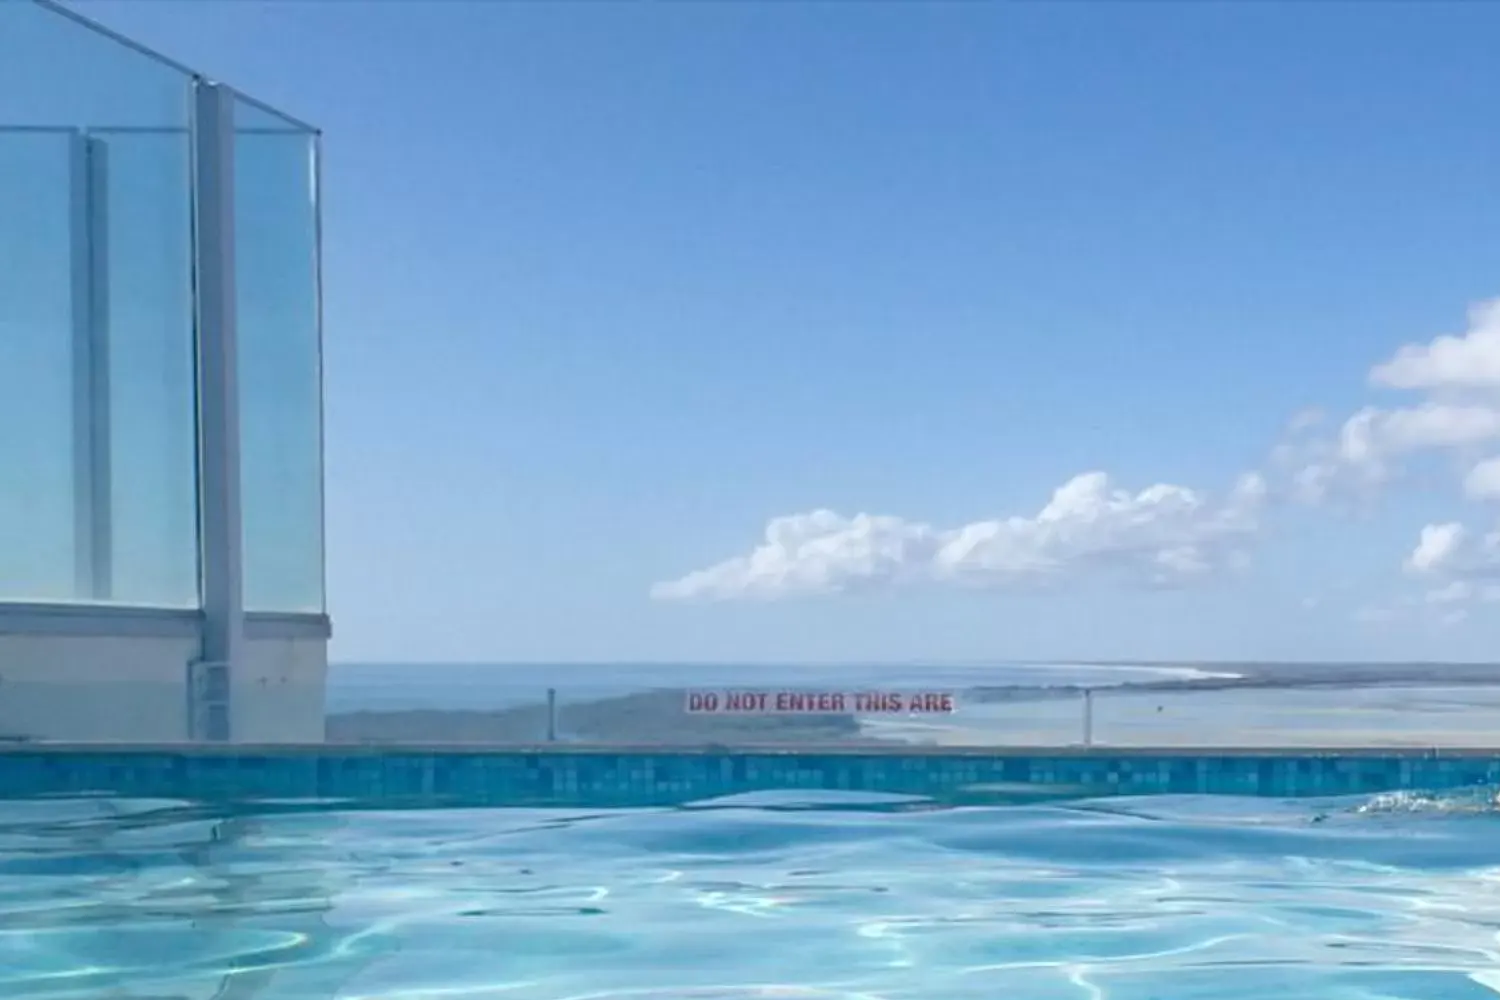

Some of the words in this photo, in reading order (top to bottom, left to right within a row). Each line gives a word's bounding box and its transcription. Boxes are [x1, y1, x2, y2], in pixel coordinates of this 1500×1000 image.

[689, 692, 718, 711] DO
[726, 692, 766, 711] NOT
[776, 692, 845, 711] ENTER
[855, 693, 902, 712] THIS
